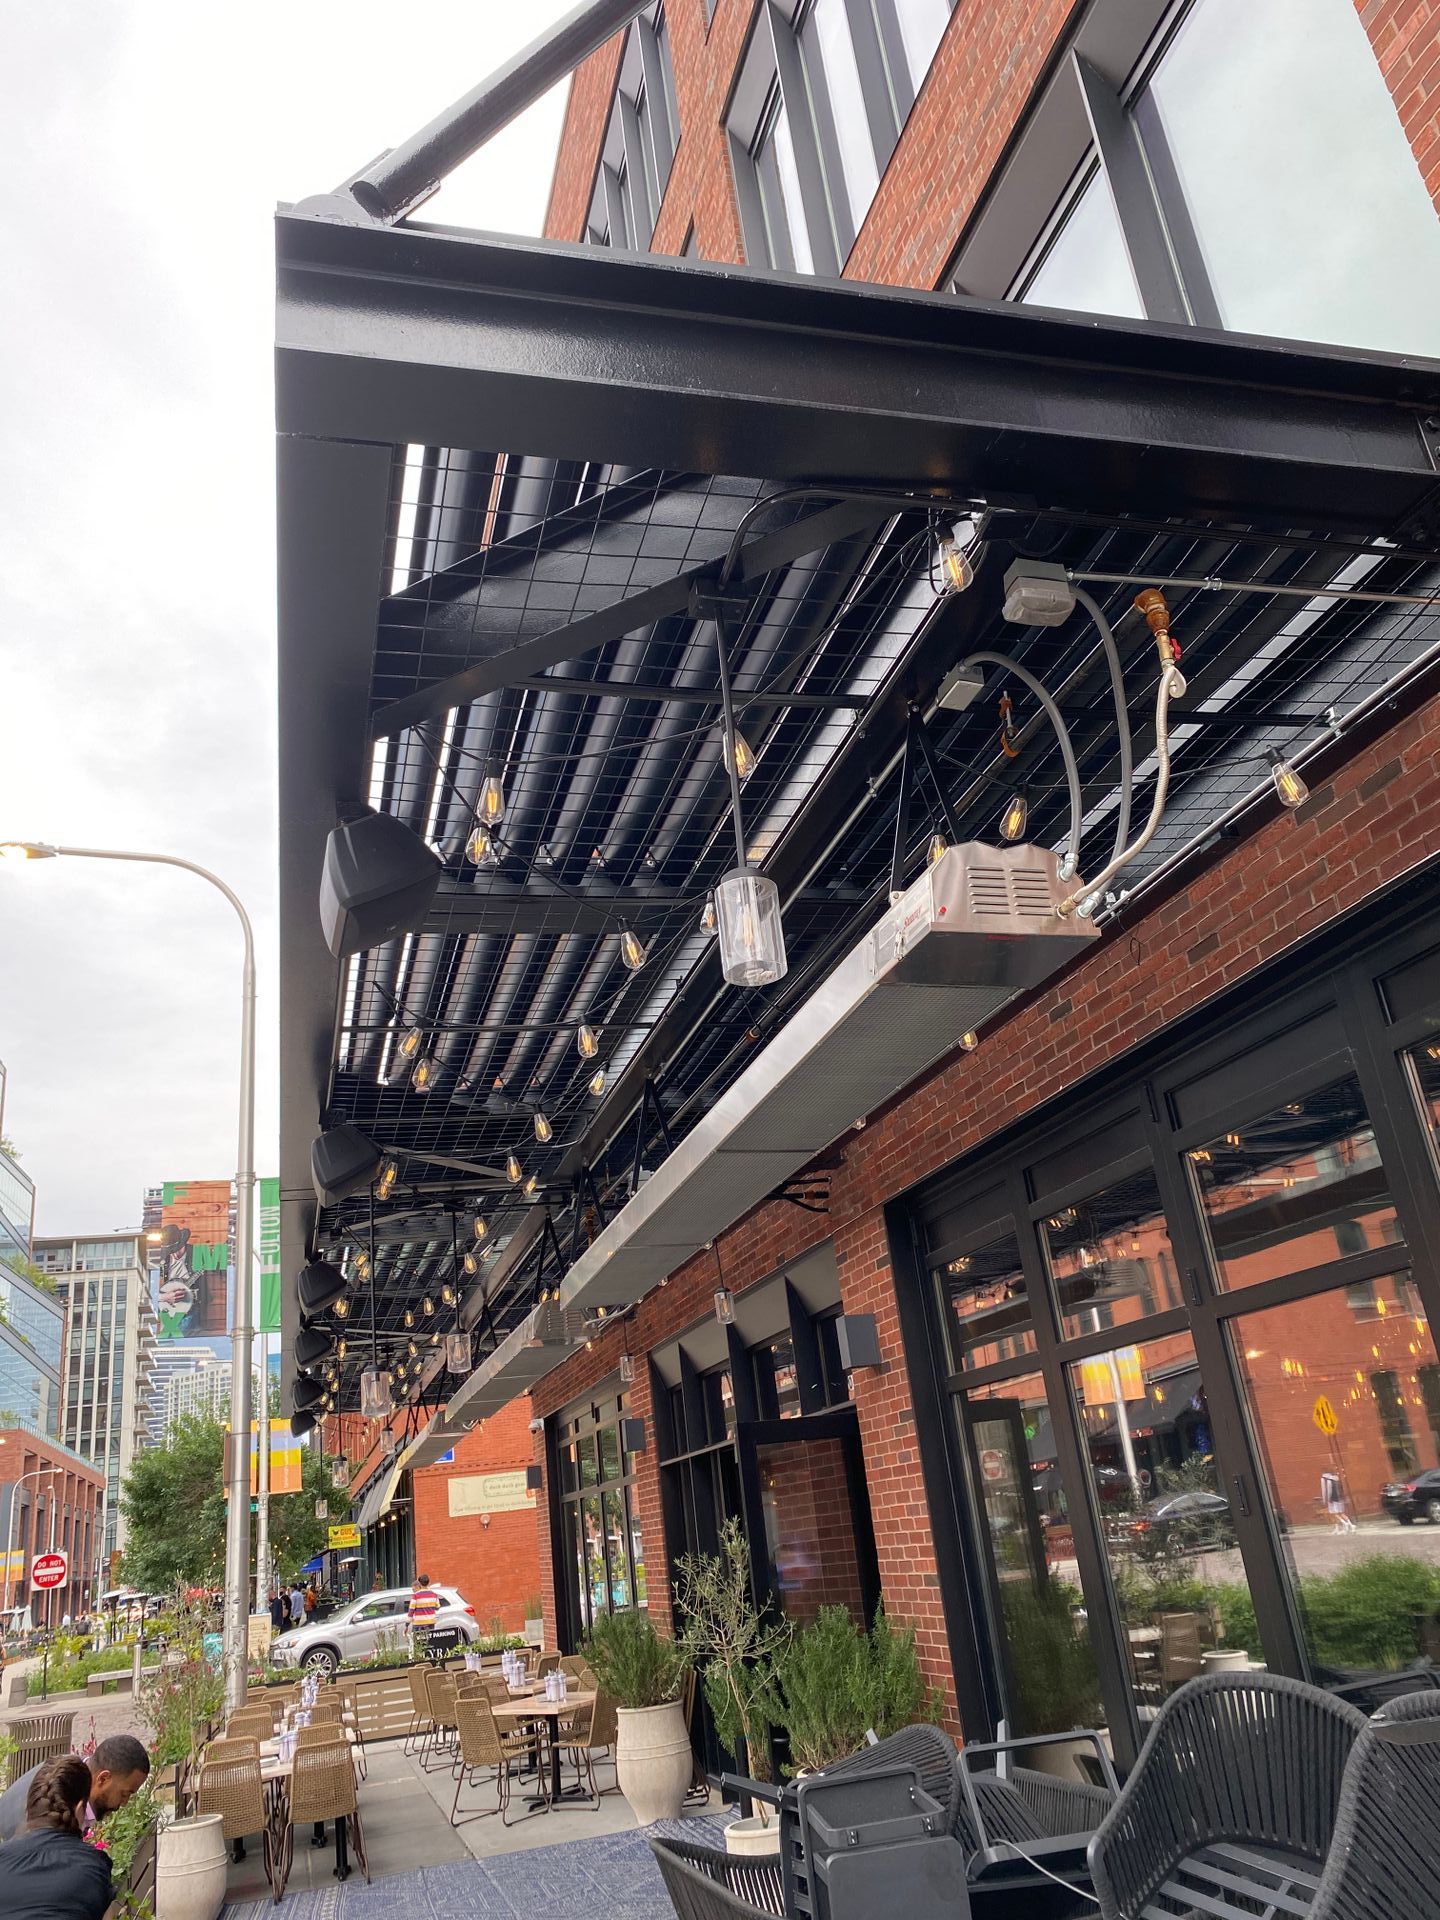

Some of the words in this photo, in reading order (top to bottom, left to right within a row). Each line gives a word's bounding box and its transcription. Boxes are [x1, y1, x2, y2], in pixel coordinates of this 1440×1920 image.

[261, 1206, 280, 1274] FULTON
[38, 1575, 59, 1583] ENTER
[433, 1630, 456, 1638] PARKING
